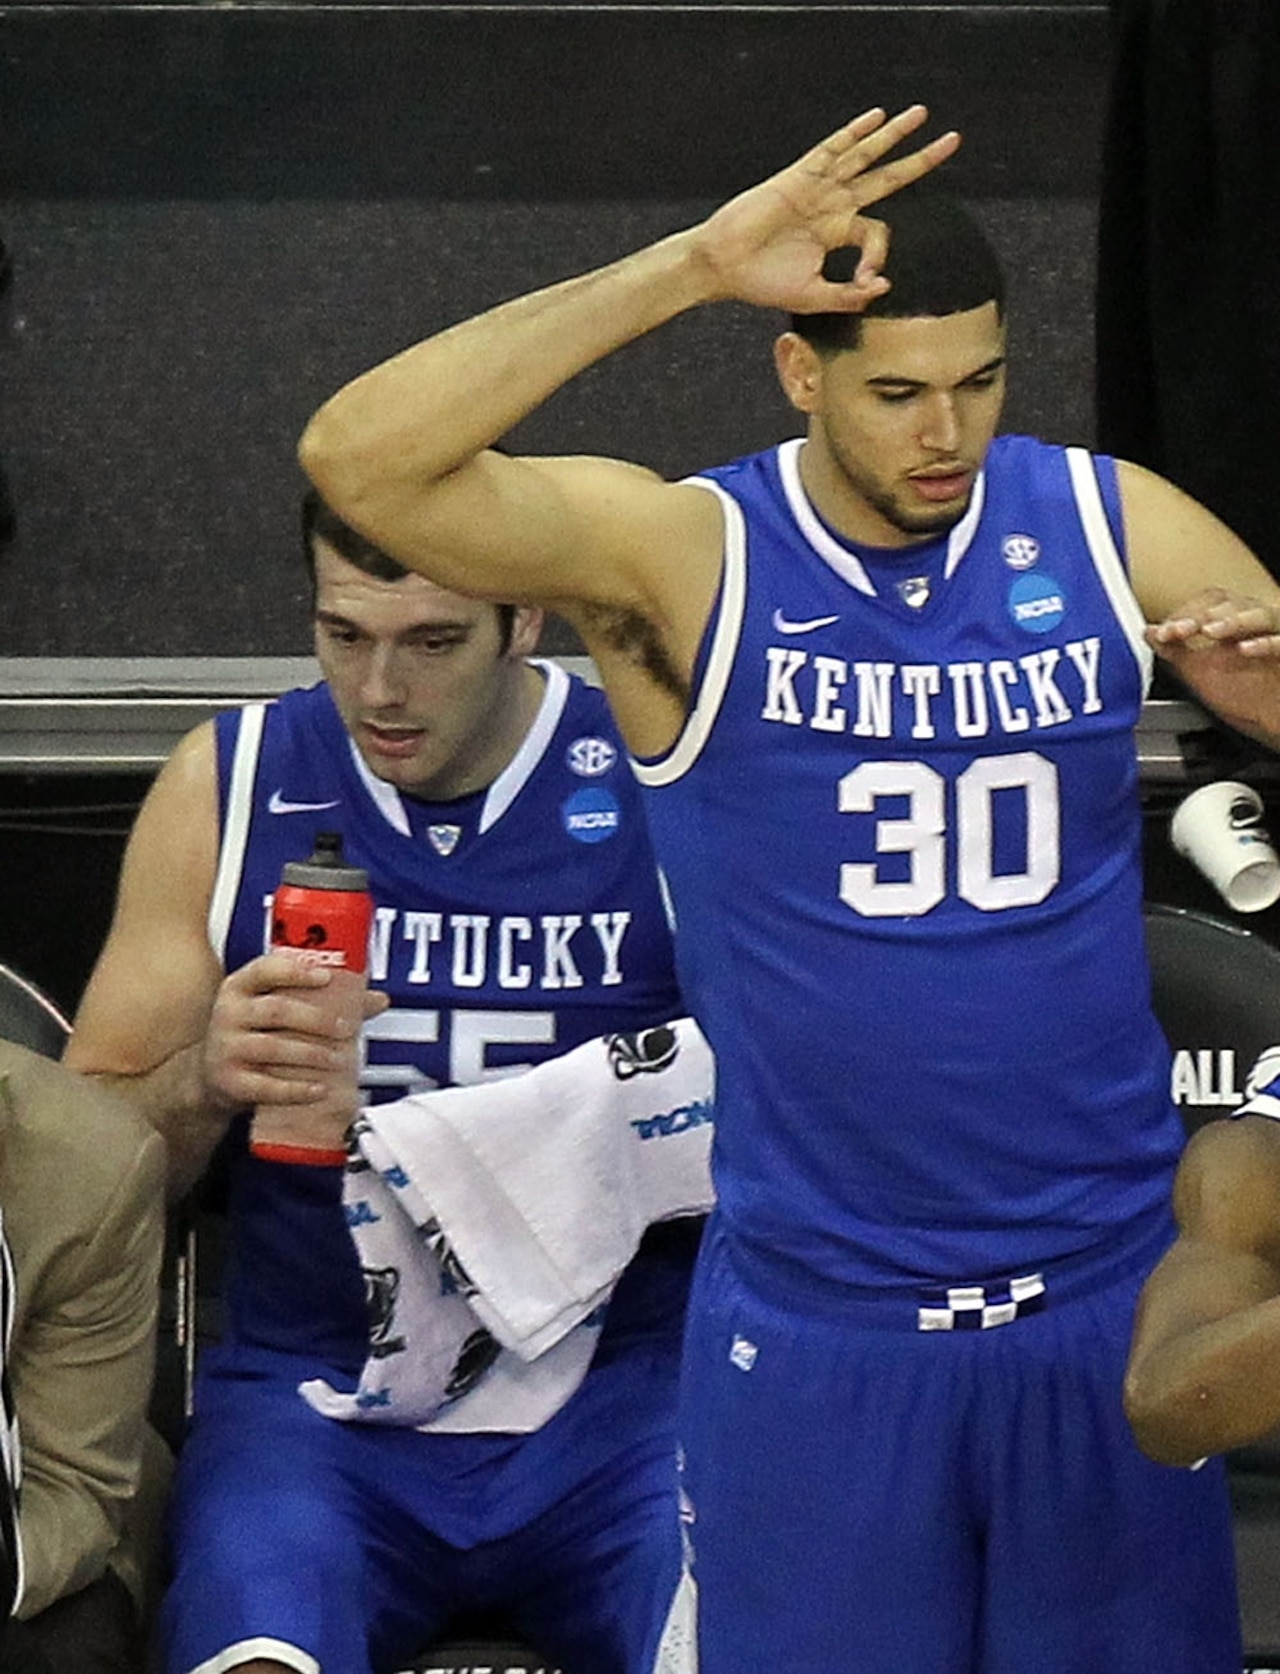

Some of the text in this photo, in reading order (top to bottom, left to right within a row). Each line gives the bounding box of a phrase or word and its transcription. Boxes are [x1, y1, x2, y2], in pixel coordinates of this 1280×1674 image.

[761, 637, 1103, 740] KENTUCKY
[837, 750, 1062, 918] 30
[1171, 1049, 1244, 1106] ALL
